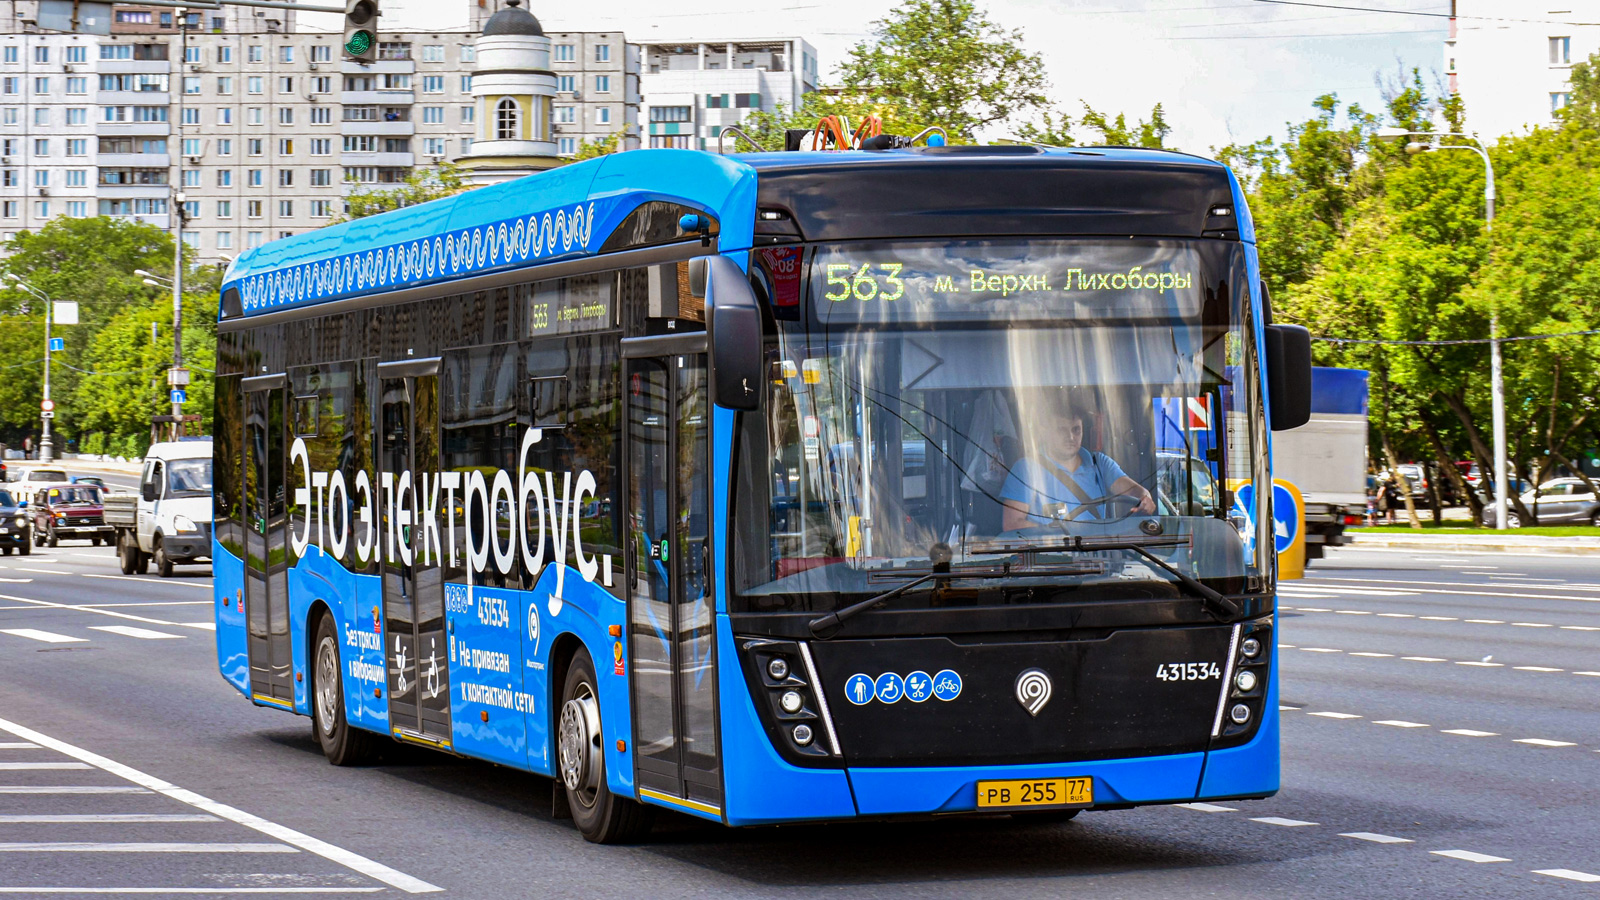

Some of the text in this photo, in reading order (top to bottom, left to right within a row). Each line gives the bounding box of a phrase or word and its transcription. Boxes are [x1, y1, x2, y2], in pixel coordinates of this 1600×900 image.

[825, 263, 904, 301] 563
[934, 276, 959, 292] м.
[970, 269, 1052, 297] Верхн.
[1064, 266, 1192, 294] Лихоборы
[533, 303, 548, 329] 563
[290, 426, 613, 617] Это электробус.
[478, 596, 510, 629] 431534
[357, 630, 381, 654] тряски
[352, 655, 385, 686] вибраций
[459, 641, 471, 667] Не
[472, 648, 510, 675] привязан
[1156, 661, 1221, 681] 431534
[461, 682, 535, 714] к контактной сети
[1020, 782, 1056, 802] 255
[1068, 780, 1085, 795] 77
